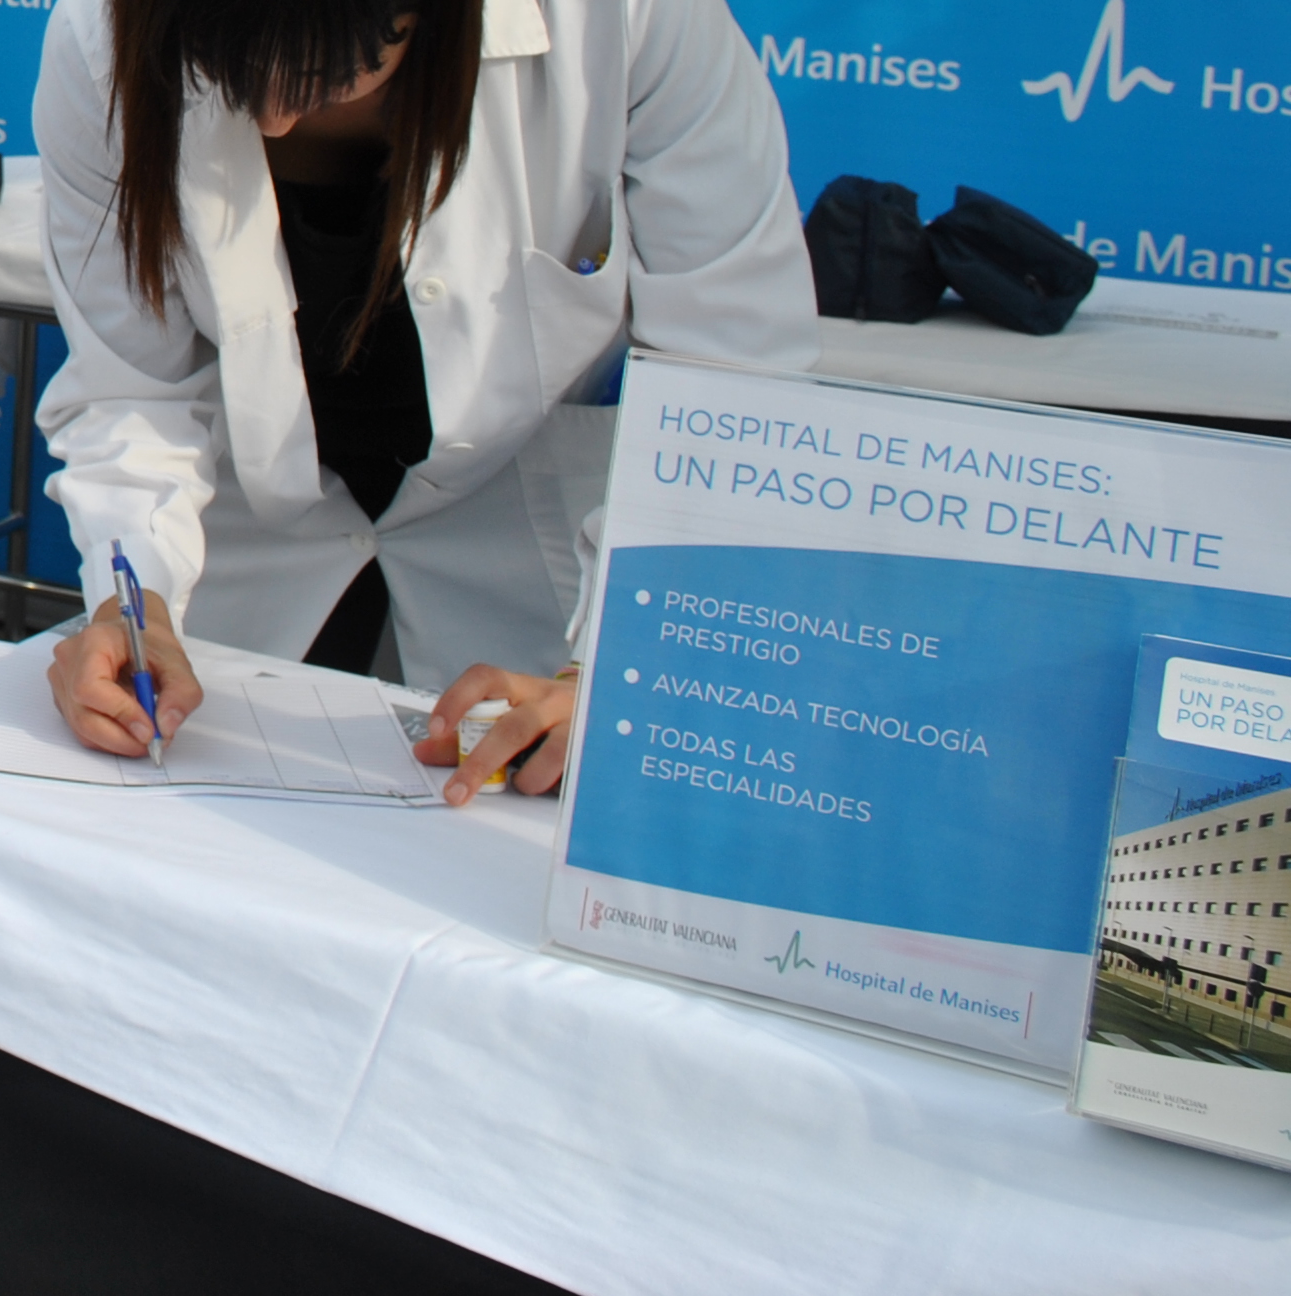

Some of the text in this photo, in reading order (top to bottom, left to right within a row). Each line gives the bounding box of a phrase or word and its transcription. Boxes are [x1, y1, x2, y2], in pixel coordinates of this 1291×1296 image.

[760, 33, 962, 93] Manises
[658, 404, 1112, 498] HOSPITAL DE MANISES:
[653, 449, 1224, 571] UN PASO POR DELANTE
[659, 620, 801, 666] PRESTIGIO
[663, 589, 941, 660] PROFESIONALES DE
[1179, 672, 1277, 697] Hospital de Manises
[1179, 688, 1285, 723] UN PASO
[651, 672, 990, 759] AVANZADA TECNOLOGÍA
[1176, 708, 1226, 733] POR
[647, 722, 797, 773] TODAS LAS
[640, 754, 873, 824] ESPECIALIDADES
[604, 906, 738, 952] GENERALITAT VALENCIANA
[825, 959, 1021, 1024] Hospital de Manises
